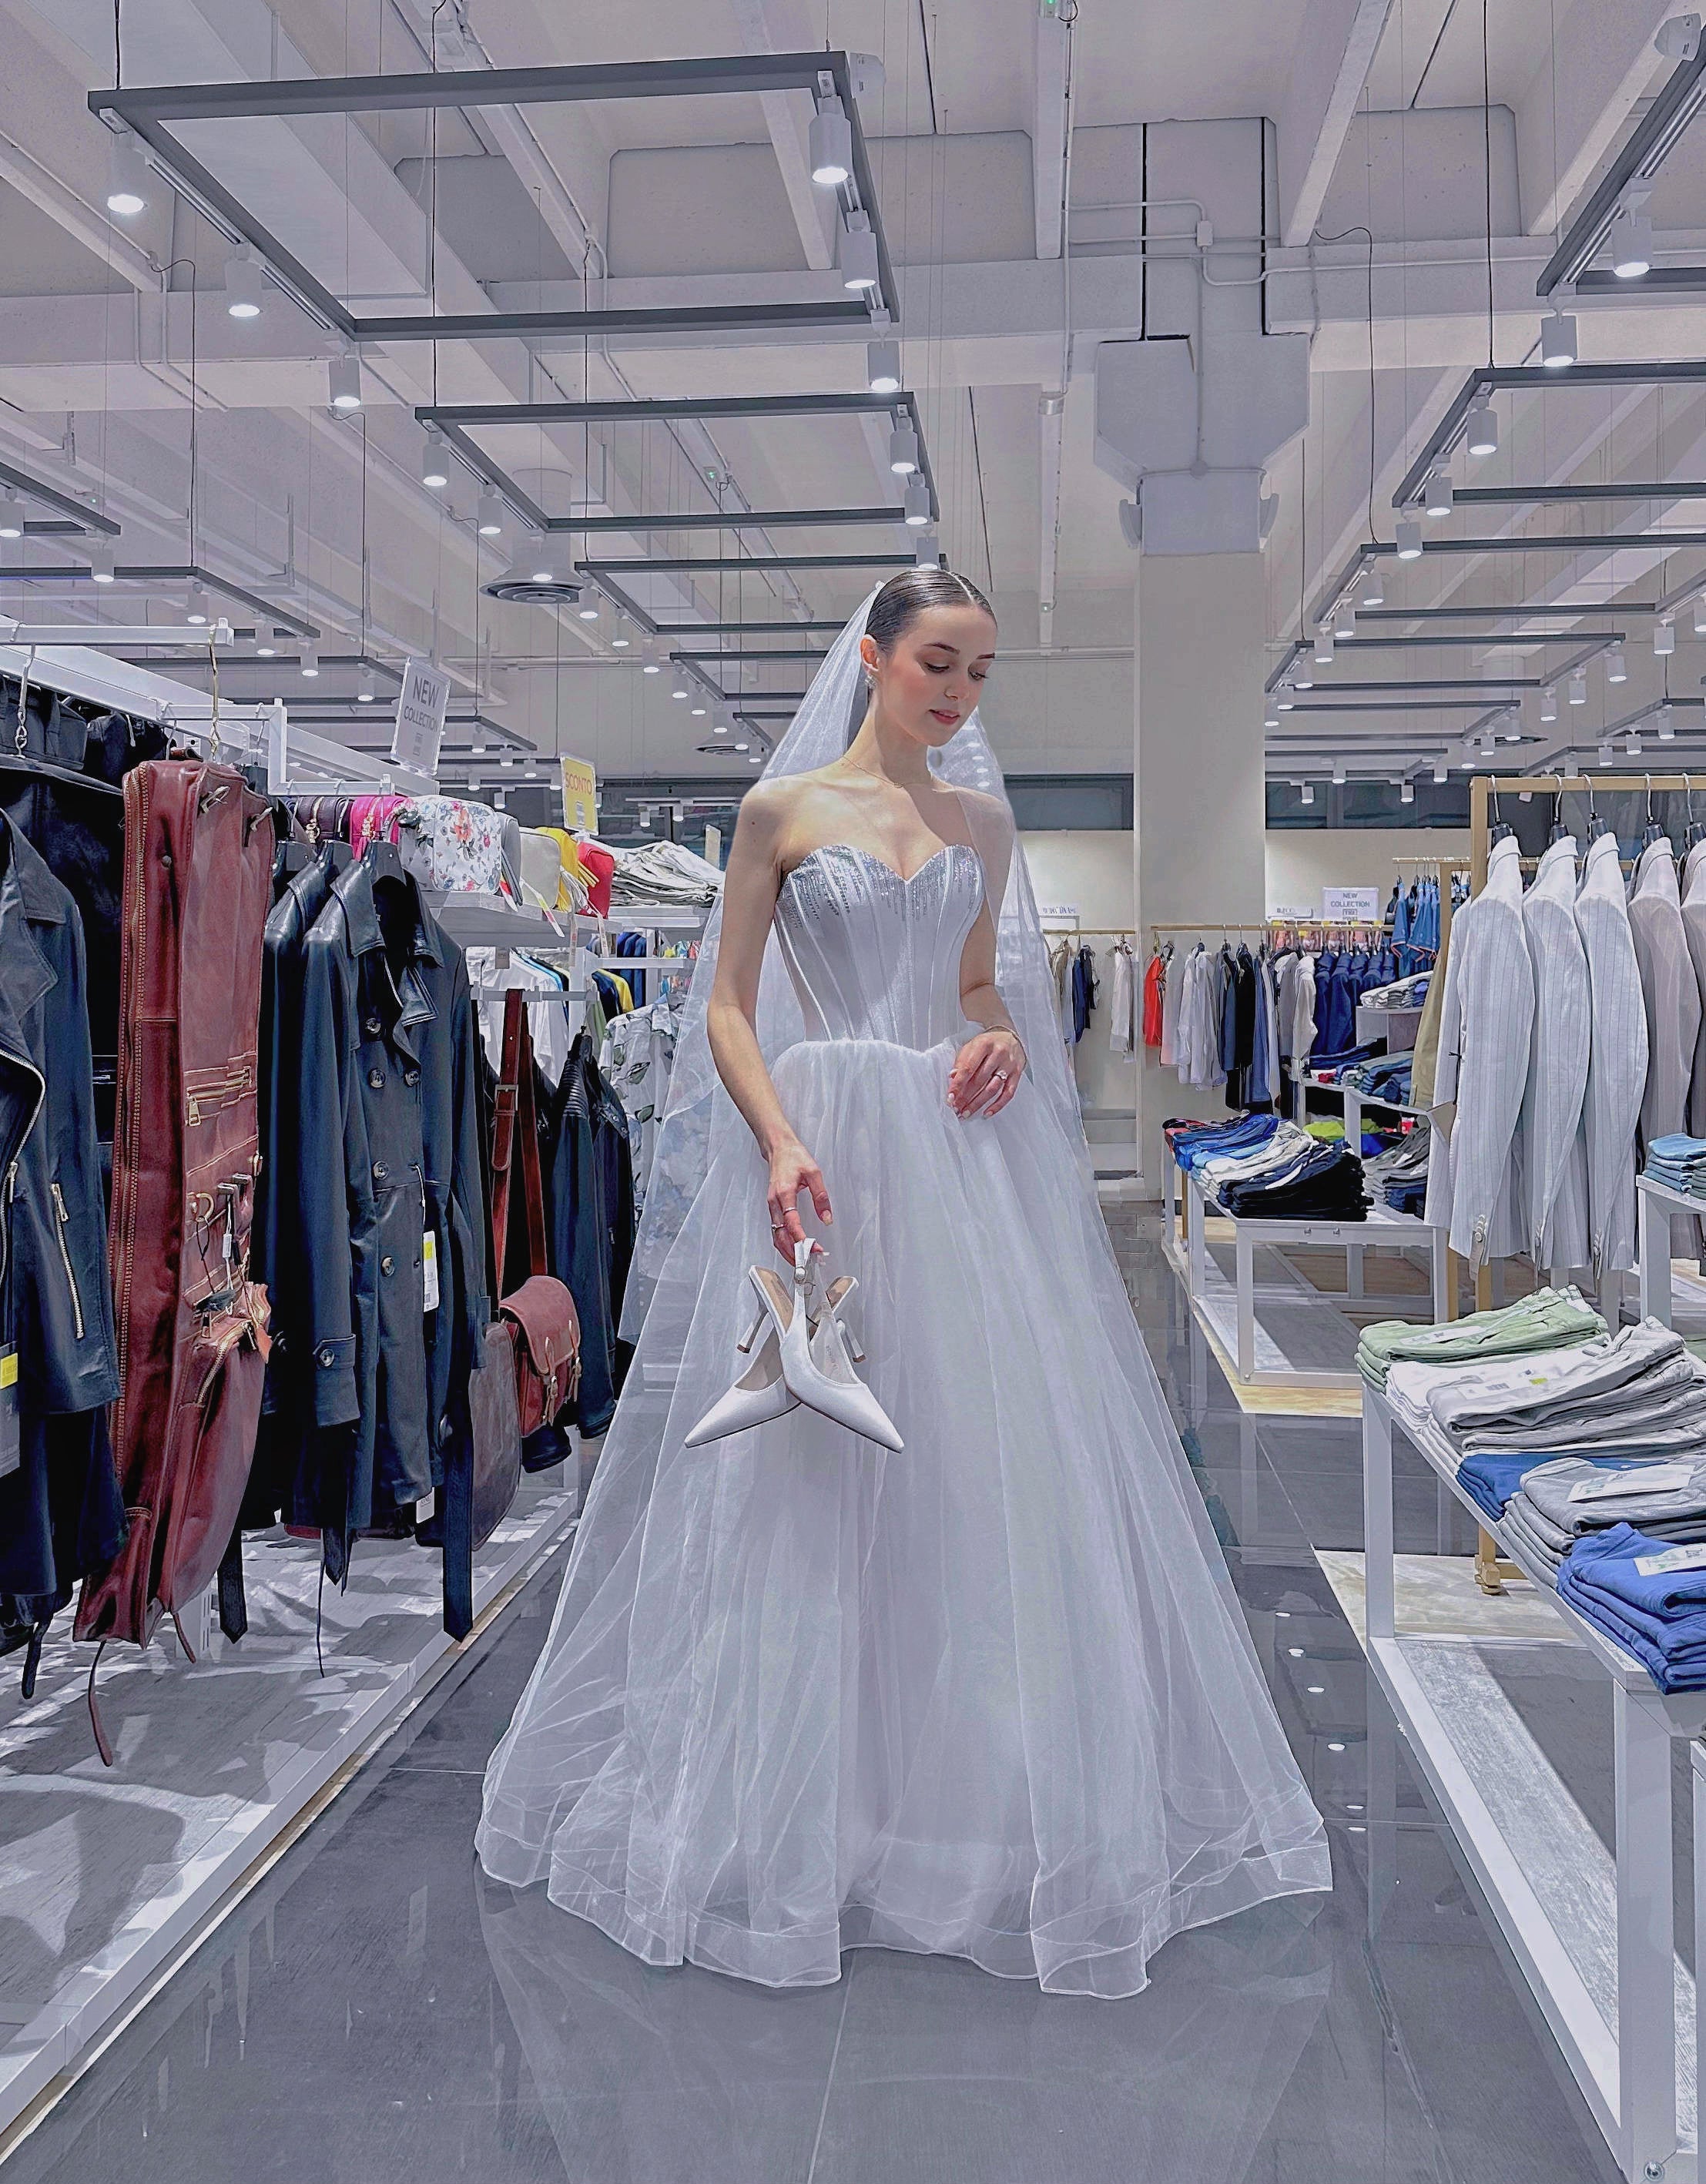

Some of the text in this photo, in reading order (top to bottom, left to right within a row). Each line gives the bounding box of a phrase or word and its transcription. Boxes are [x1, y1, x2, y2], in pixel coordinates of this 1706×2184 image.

[413, 675, 440, 708] NEW
[404, 705, 438, 732] COLLECTION
[565, 772, 592, 796] SCONTO
